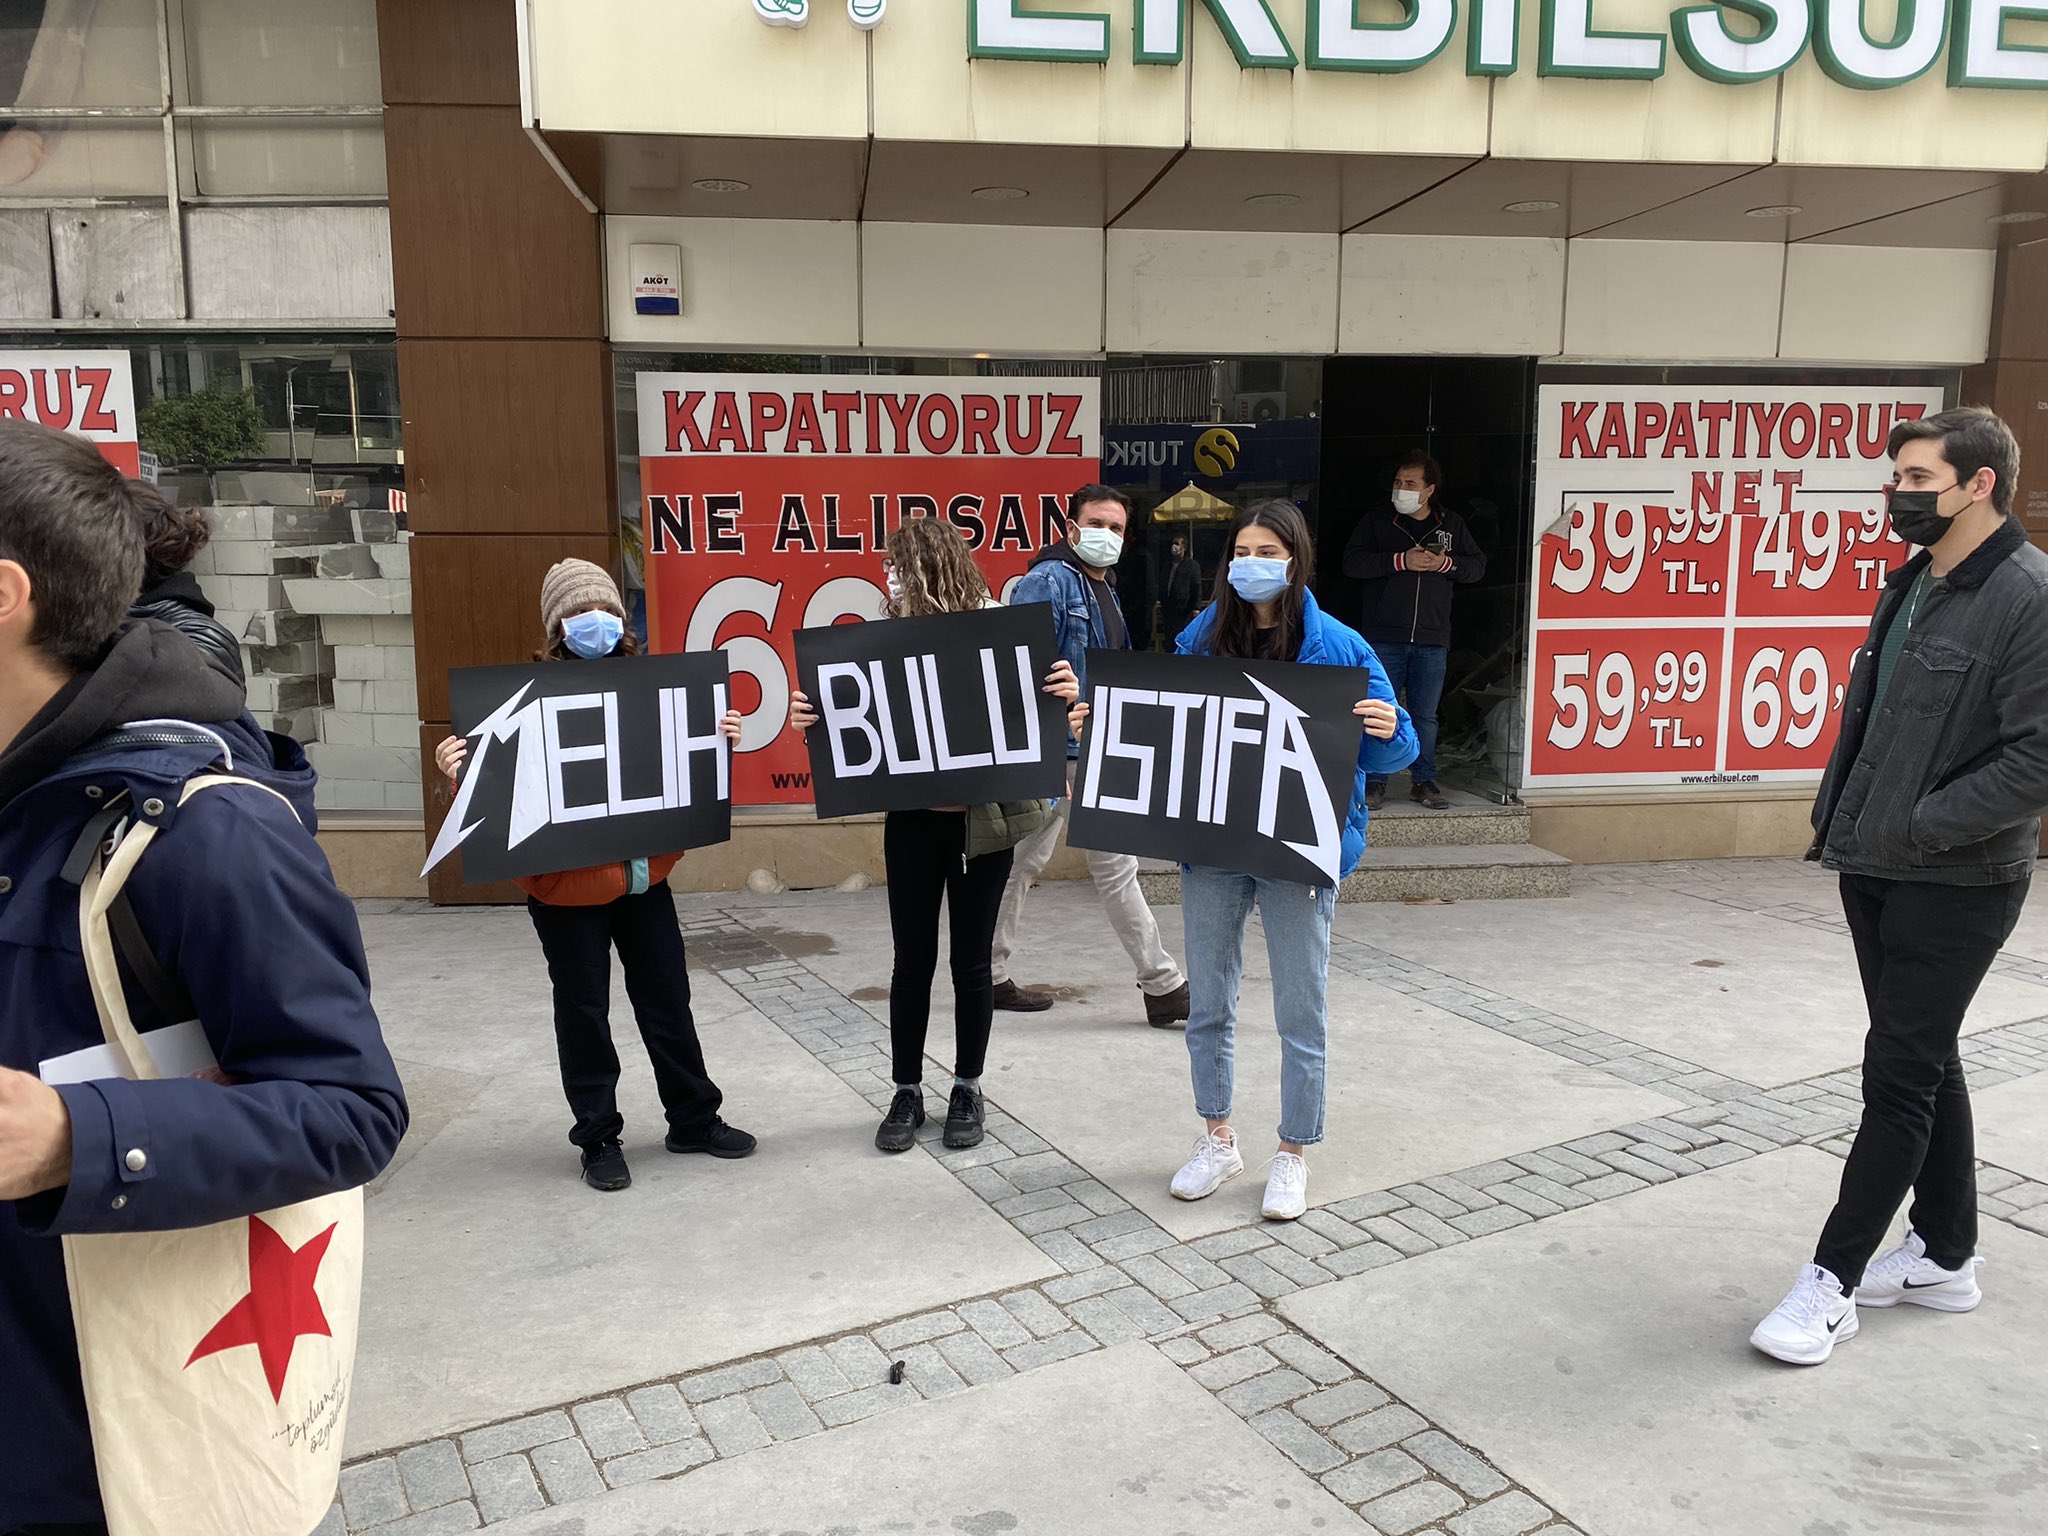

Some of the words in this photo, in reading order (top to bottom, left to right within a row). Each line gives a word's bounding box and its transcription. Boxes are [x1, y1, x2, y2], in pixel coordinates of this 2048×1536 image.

[662, 389, 1083, 457] KAPATIYORUZ
[647, 491, 745, 555] NE
[1690, 468, 1804, 517] NET
[1662, 559, 1722, 594] TL.
[817, 645, 1041, 779] BULU
[1547, 648, 1708, 750] 59,99
[1650, 716, 1703, 748] TL.
[419, 678, 729, 878] MELIH
[1081, 671, 1342, 891] ISTIFA
[1680, 772, 1760, 784] www.erbilsuel.com
